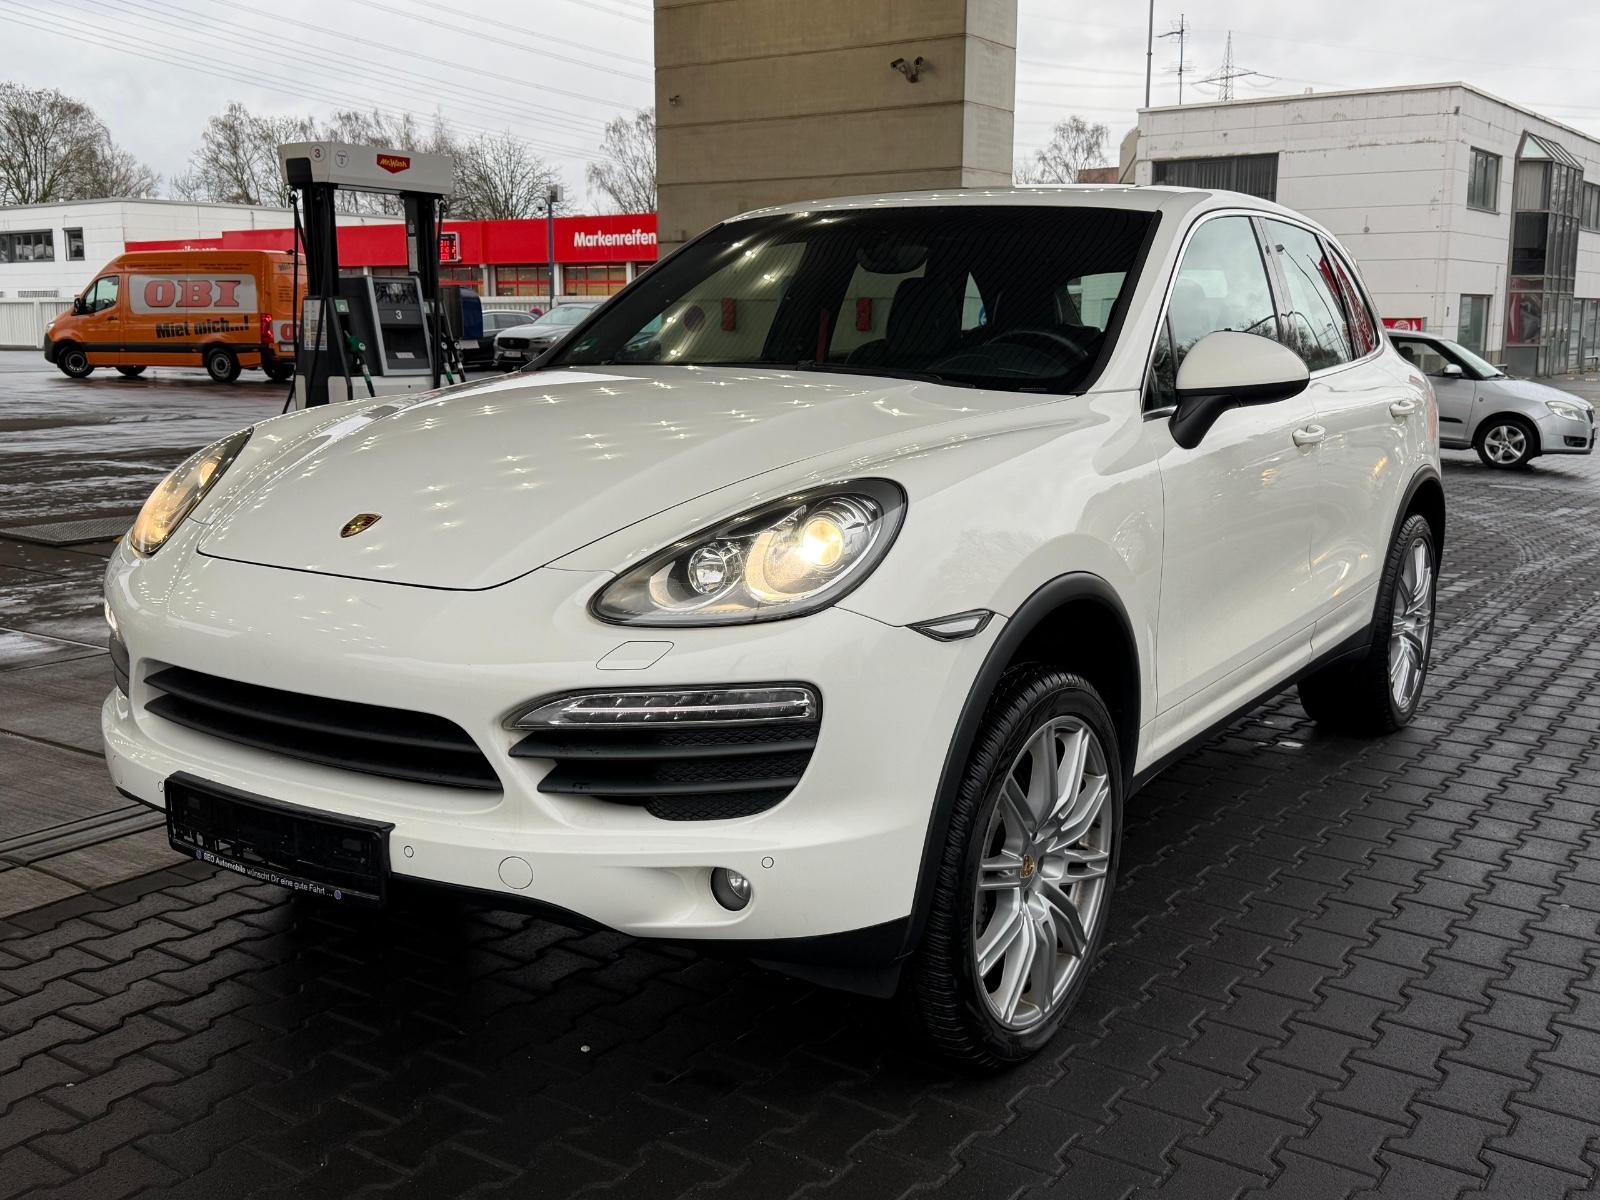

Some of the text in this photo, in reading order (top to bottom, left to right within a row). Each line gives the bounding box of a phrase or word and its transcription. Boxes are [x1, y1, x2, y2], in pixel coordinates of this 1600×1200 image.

[315, 149, 320, 158] 3
[574, 228, 657, 247] Markenreifen
[144, 280, 241, 307] OBI
[395, 310, 402, 320] 3
[156, 321, 191, 339] Miet
[215, 857, 246, 874] Automobile
[270, 874, 280, 884] Dir
[280, 879, 293, 887] eine
[293, 881, 308, 891] gute
[308, 883, 326, 896] Fahrt
